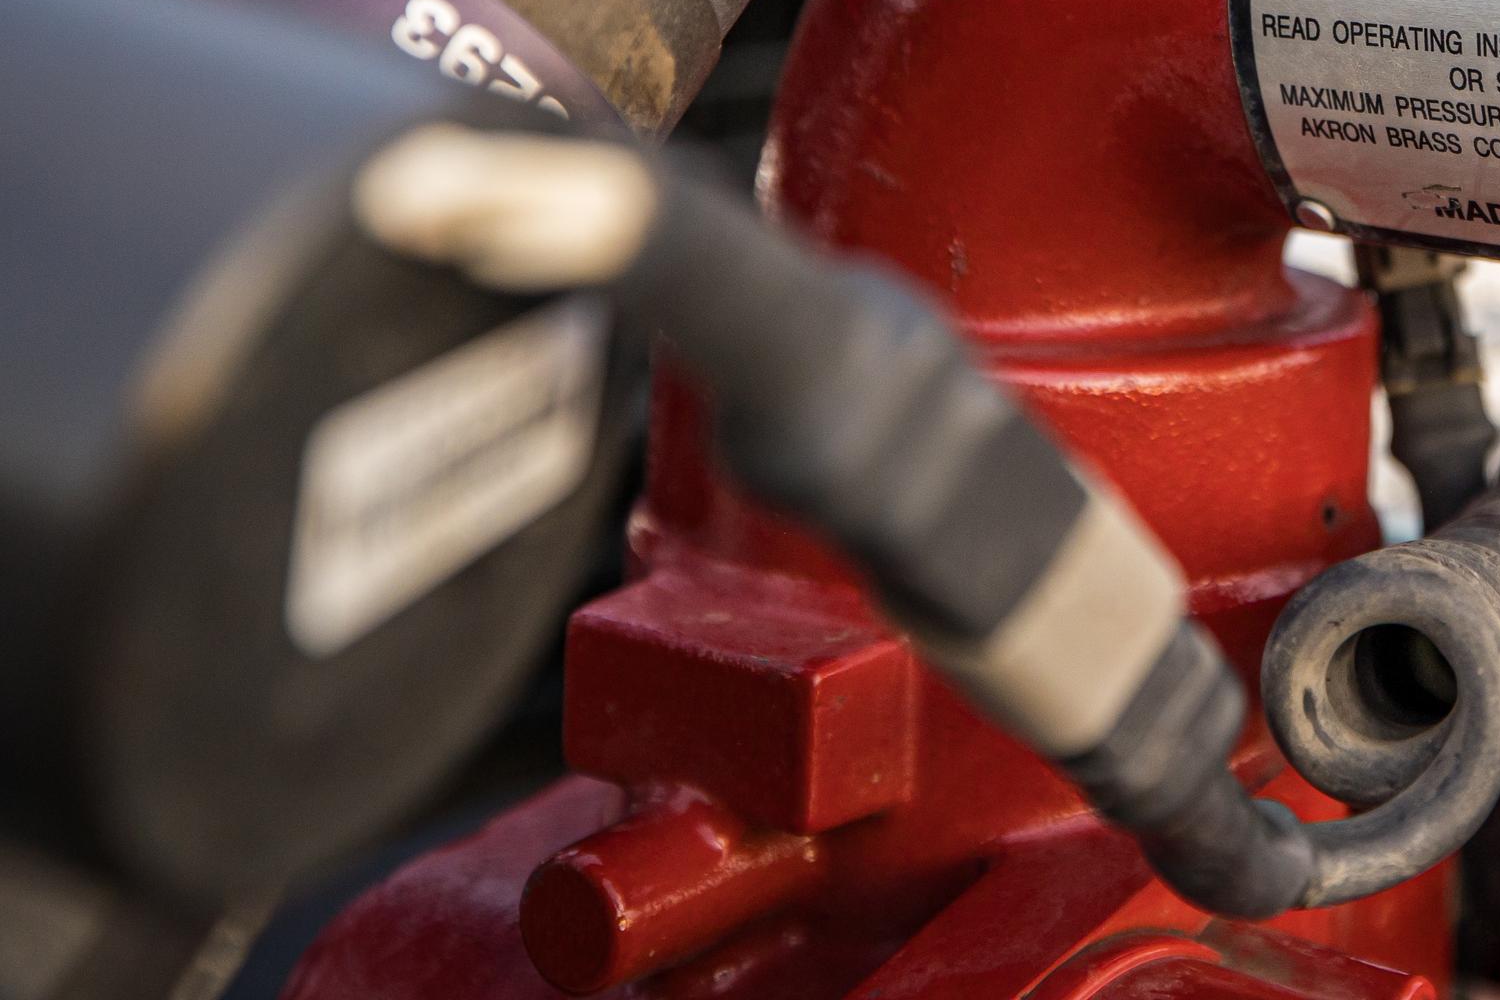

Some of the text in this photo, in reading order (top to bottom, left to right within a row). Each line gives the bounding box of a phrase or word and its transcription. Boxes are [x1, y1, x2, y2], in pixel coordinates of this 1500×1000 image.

[1262, 13, 1320, 41] READ
[1333, 20, 1463, 55] OPERATING
[1449, 67, 1485, 92] OR
[1280, 84, 1384, 115] MAXIMUM
[1302, 117, 1376, 144] AKRON
[1386, 127, 1462, 154] BRASS
